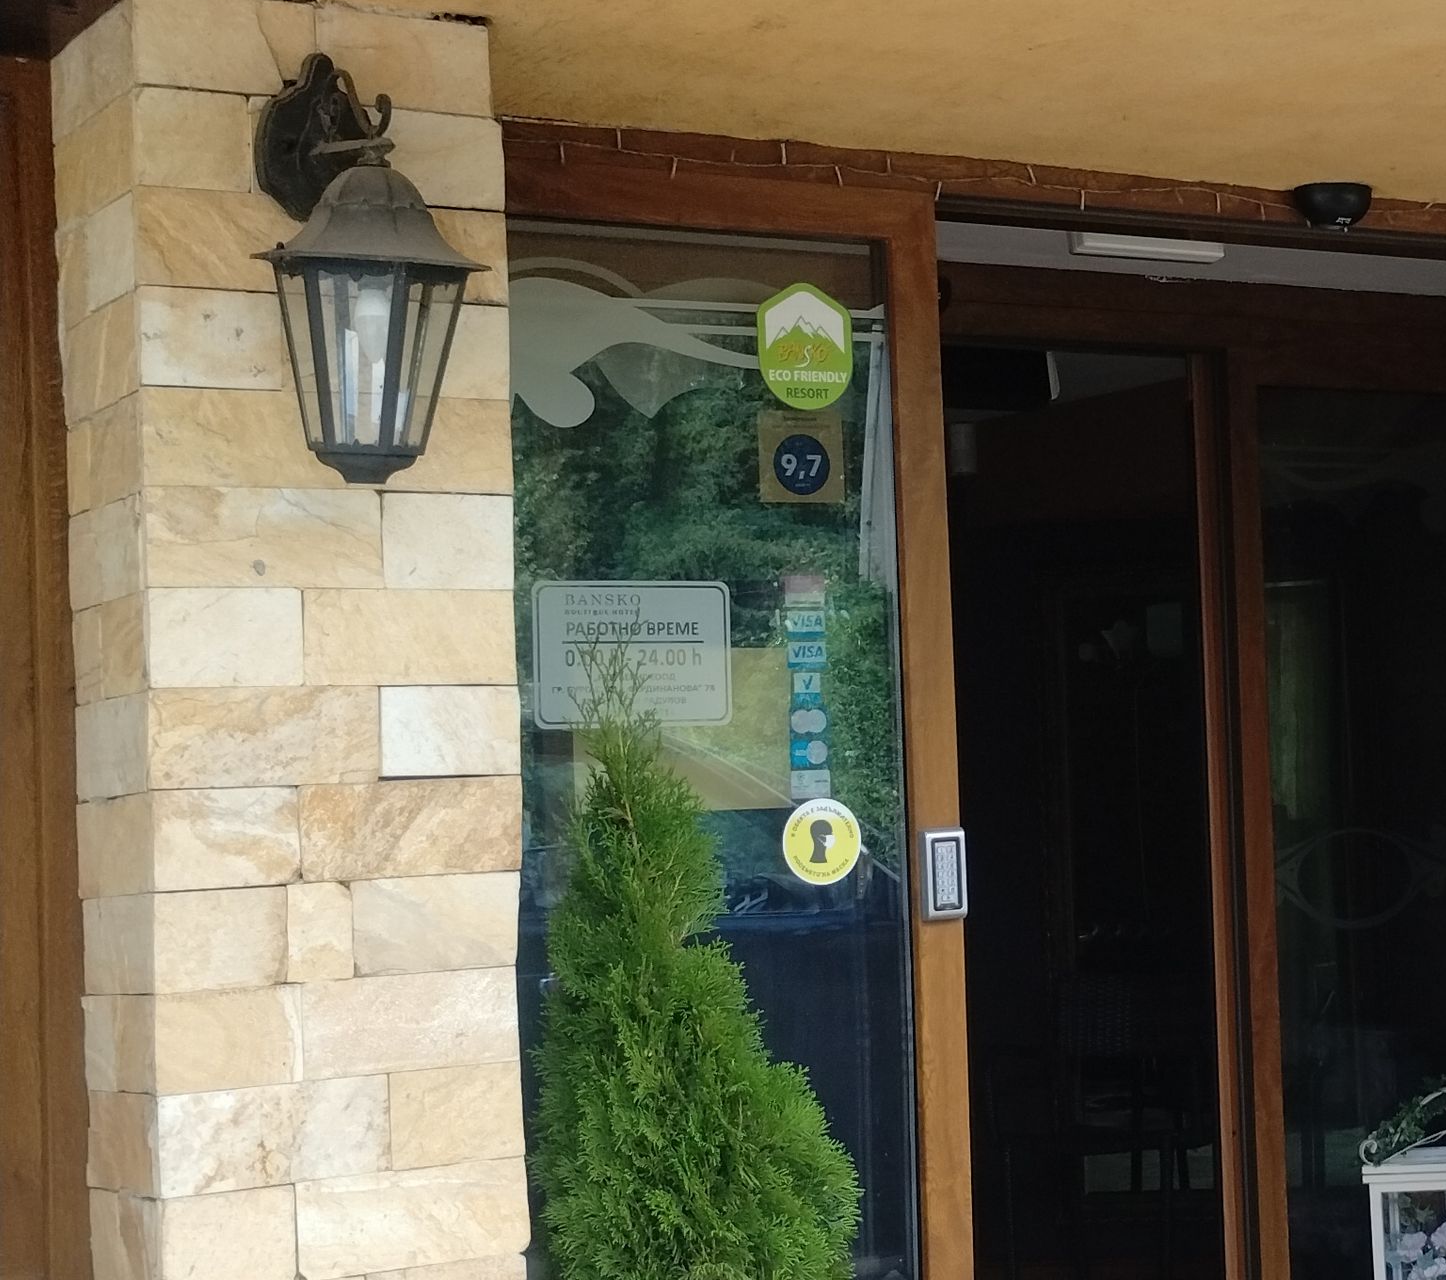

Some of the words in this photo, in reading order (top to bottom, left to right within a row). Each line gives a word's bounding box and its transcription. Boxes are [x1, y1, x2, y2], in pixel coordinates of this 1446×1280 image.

[768, 369, 791, 381] ECO
[793, 370, 847, 383] FRIENDLY
[786, 387, 829, 399] RESORT
[781, 453, 821, 479] 9,7
[564, 594, 641, 607] BANSKO
[566, 622, 642, 636] РАБОТНО
[647, 622, 699, 636] ВРЕМЕ
[638, 649, 687, 666] 24.00
[692, 648, 702, 666] h
[792, 646, 823, 658] VISA
